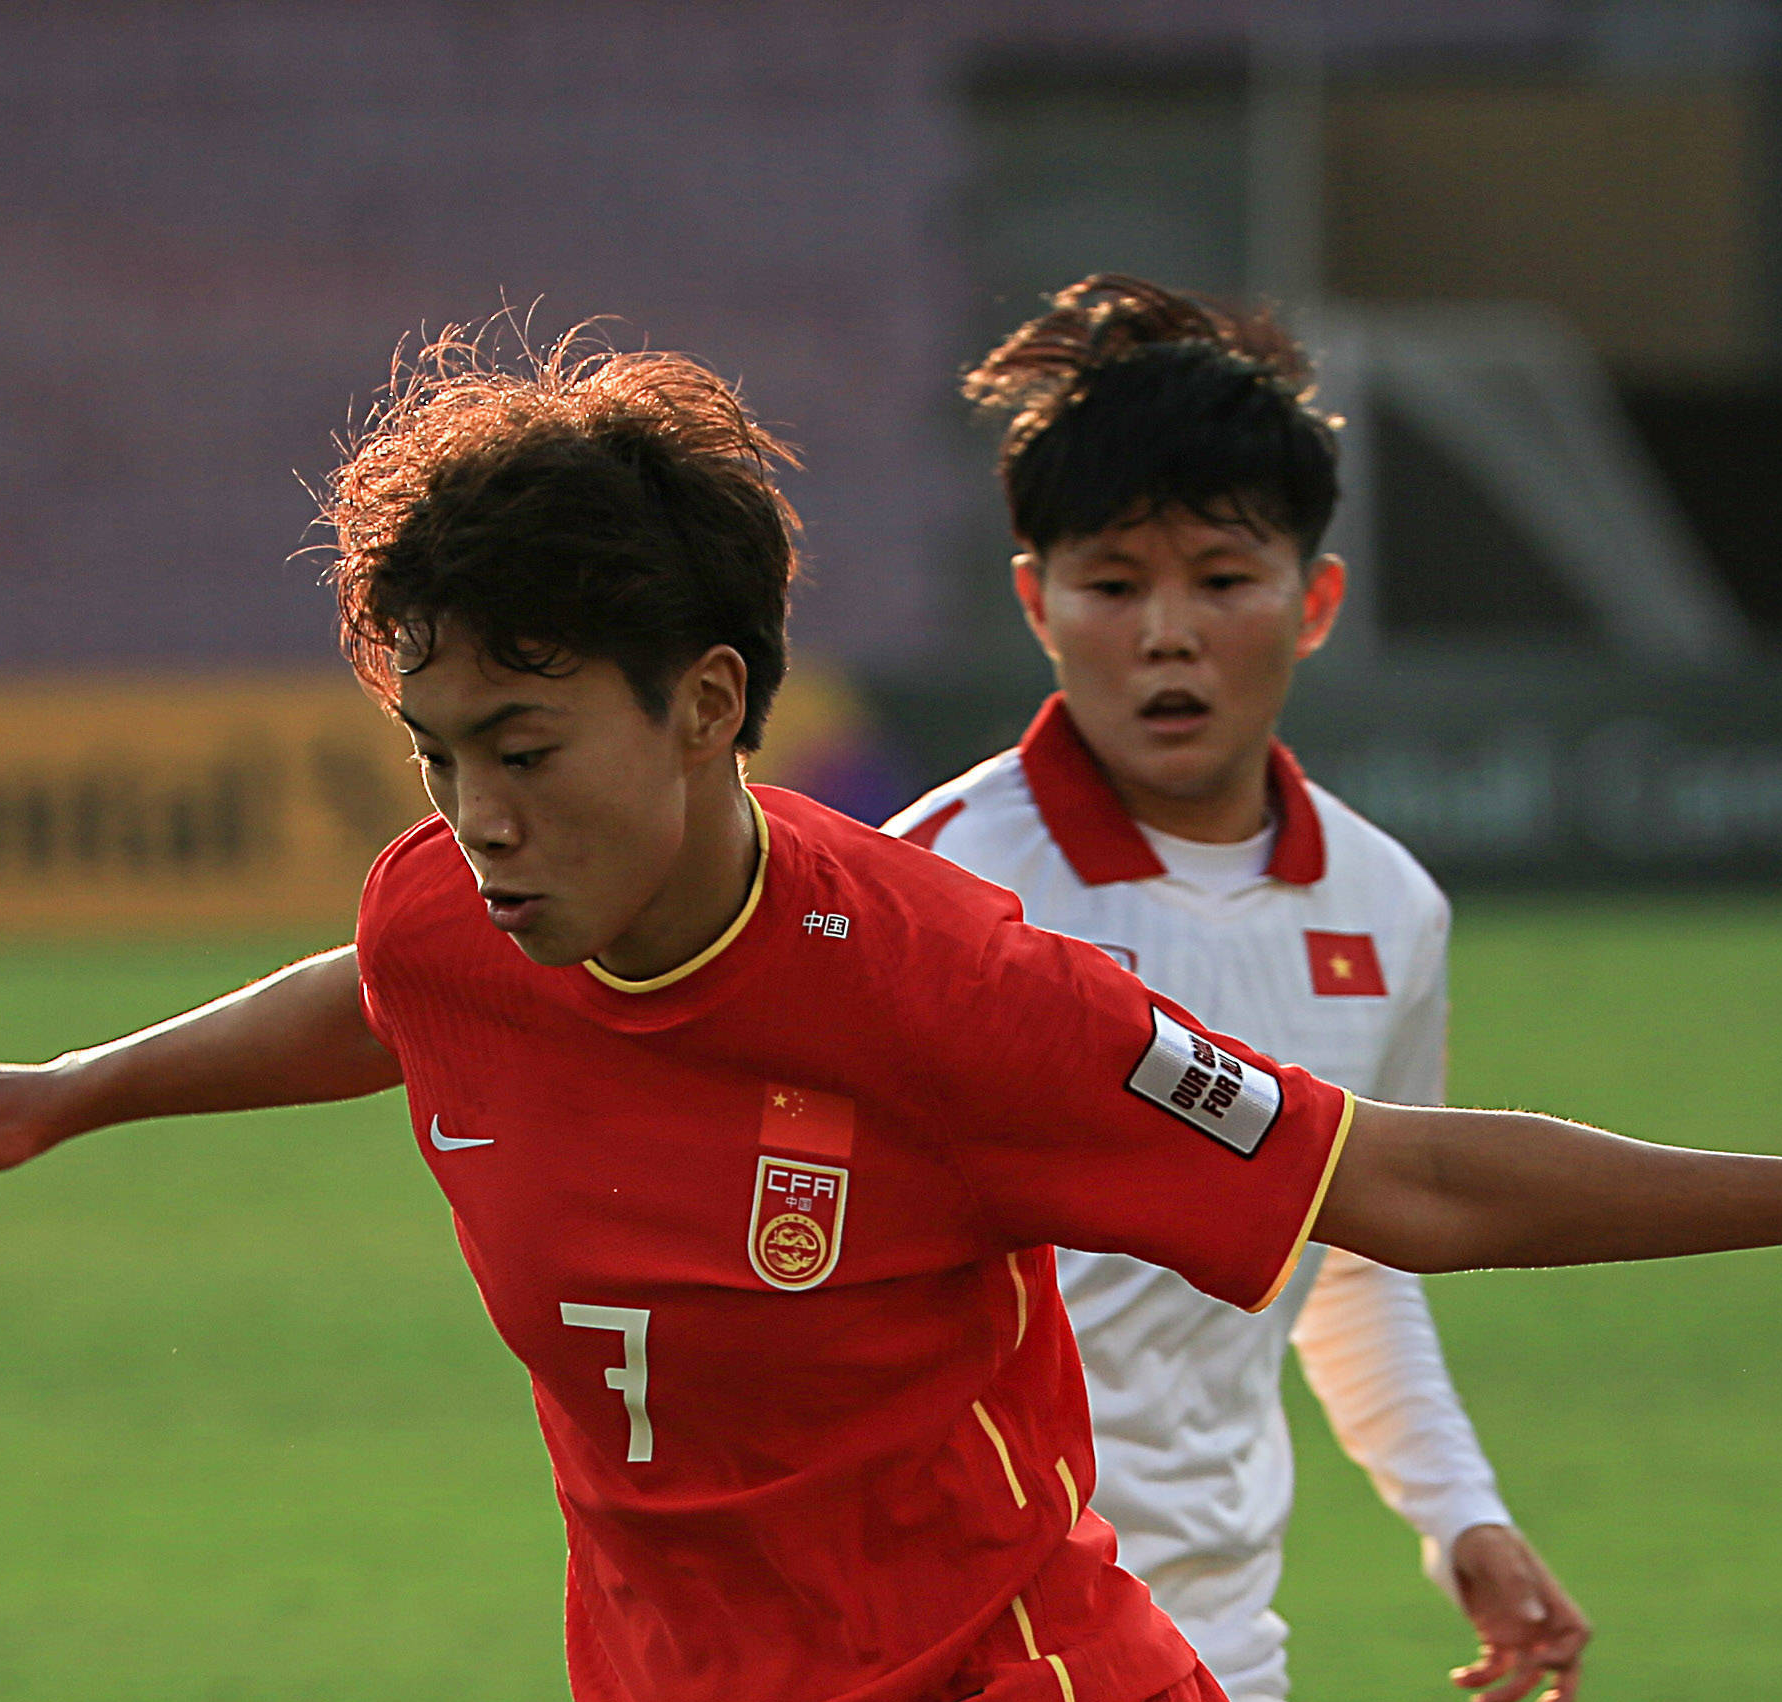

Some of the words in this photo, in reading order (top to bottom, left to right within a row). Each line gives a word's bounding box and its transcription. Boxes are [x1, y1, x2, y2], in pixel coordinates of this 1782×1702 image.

[802, 910, 849, 939] 中国
[1170, 1066, 1212, 1110] OUR
[1201, 1075, 1242, 1118] FOR
[767, 1169, 835, 1199] CFA
[559, 1302, 653, 1462] 7
